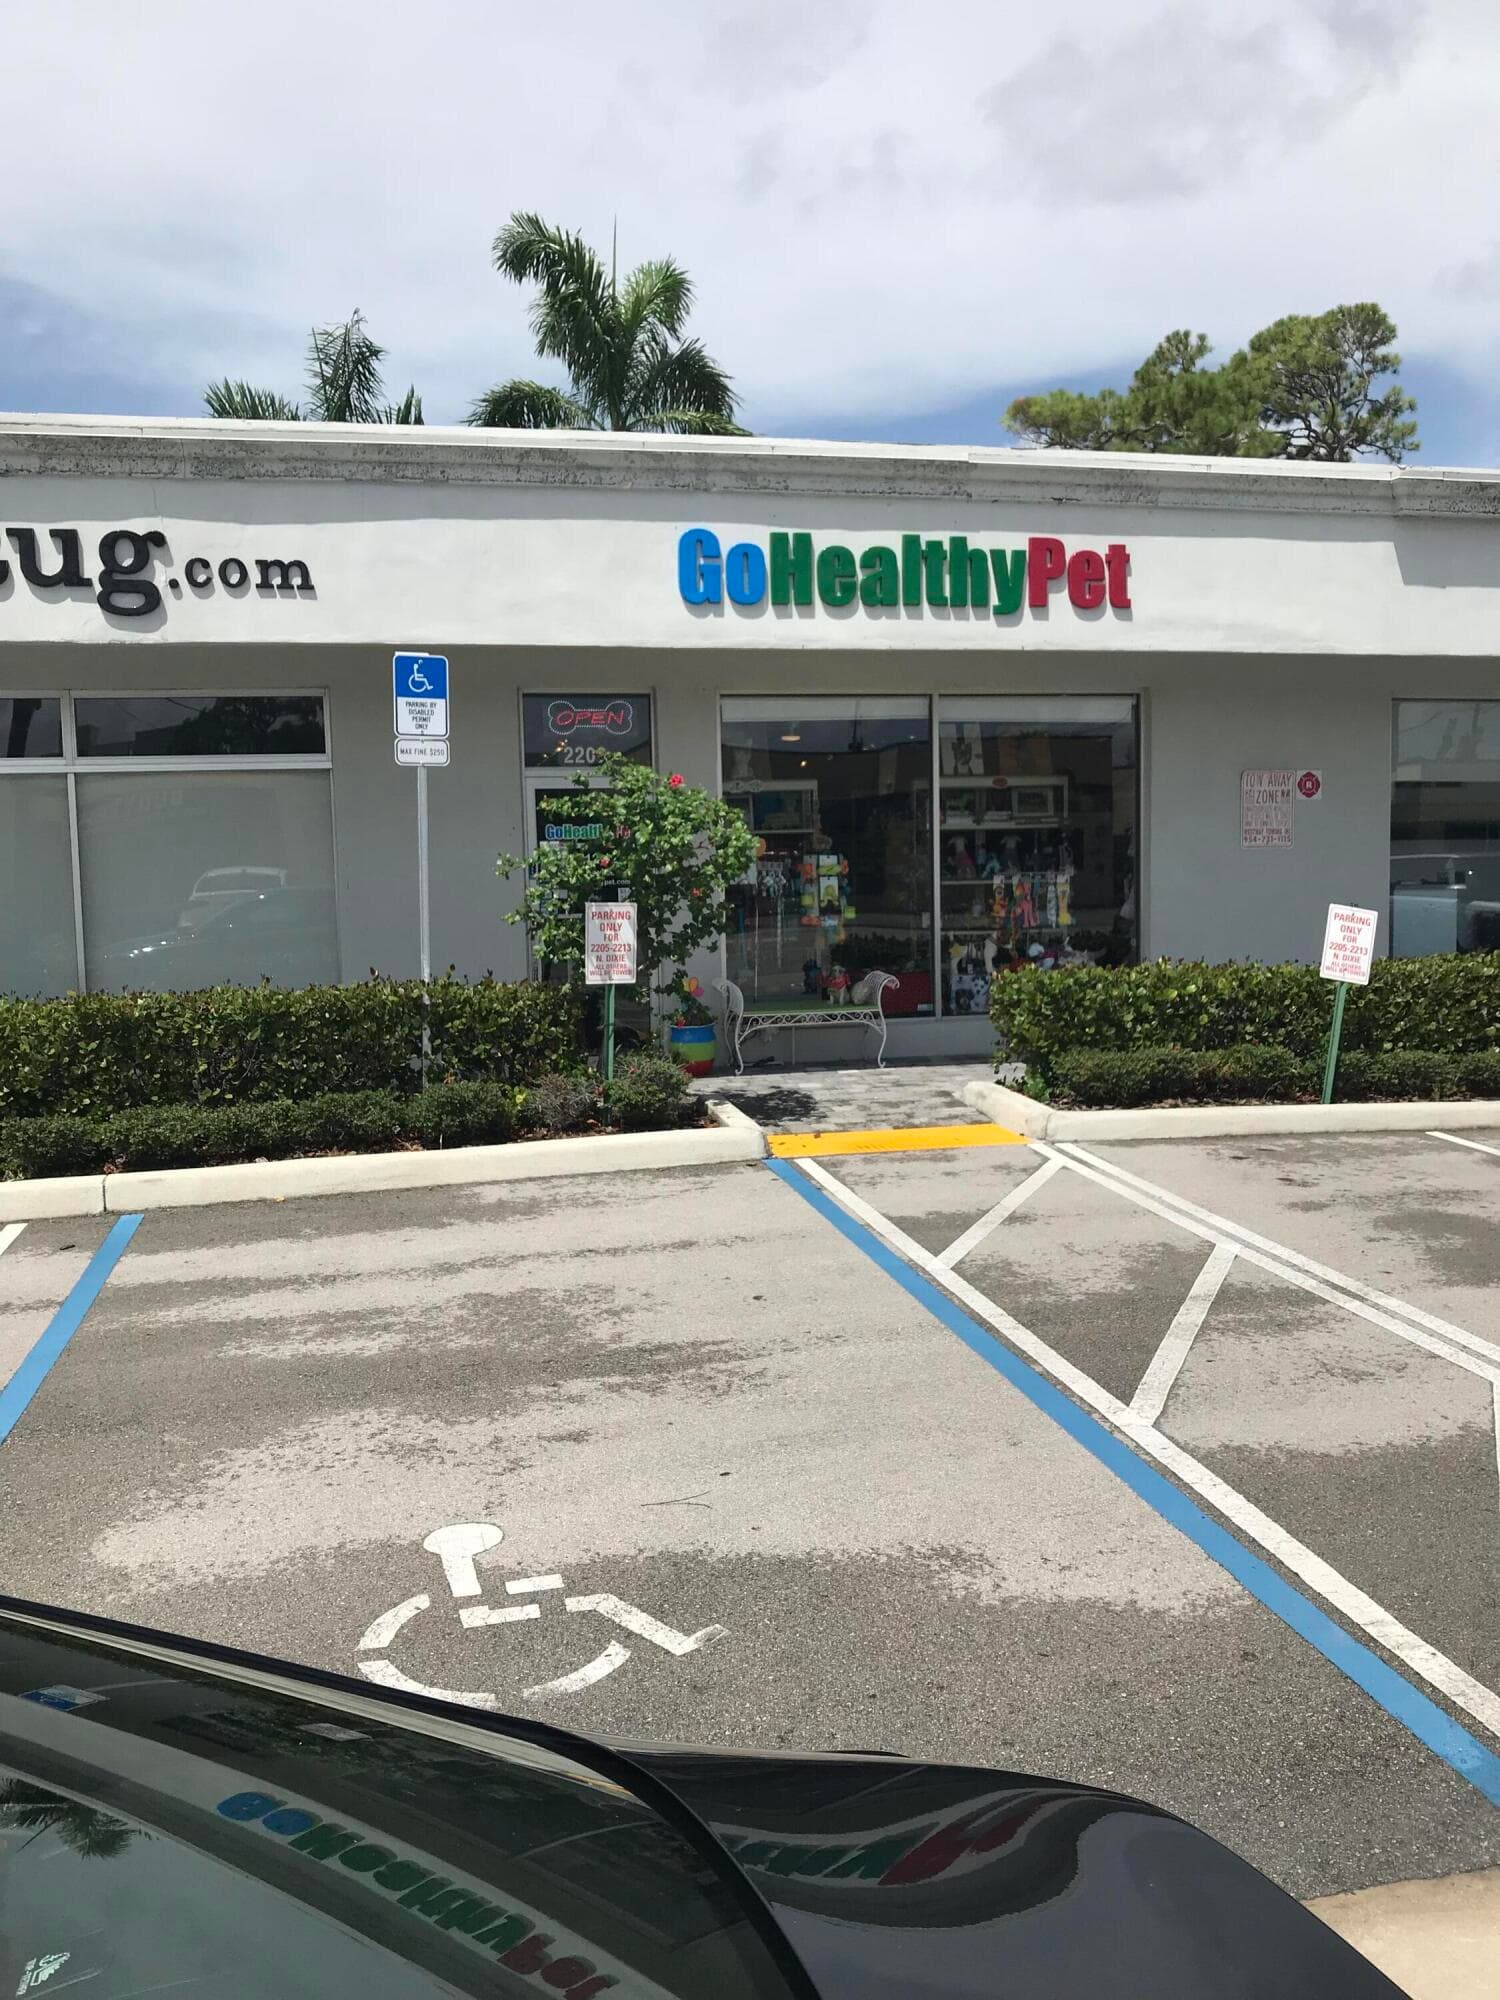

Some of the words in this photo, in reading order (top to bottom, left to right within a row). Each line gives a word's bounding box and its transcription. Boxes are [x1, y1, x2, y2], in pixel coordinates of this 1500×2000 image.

[0, 527, 315, 617] ug.com
[678, 528, 1132, 615] GoHealthyPet
[556, 710, 624, 726] OPEN
[414, 748, 426, 756] FINE
[430, 748, 445, 756] $250
[1268, 773, 1292, 788] AWAY
[1256, 789, 1280, 805] ZONE
[591, 911, 632, 921] PARKING
[1334, 912, 1371, 927] PARKING
[600, 922, 623, 932] ONLY
[1340, 924, 1362, 936] ONLY
[603, 933, 620, 942] FOR
[1343, 934, 1357, 944] FOR
[591, 943, 632, 953] 2205-2213
[1329, 942, 1368, 955] 2205-2213
[606, 954, 625, 962] DIXIE
[1342, 954, 1361, 964] DIXIE
